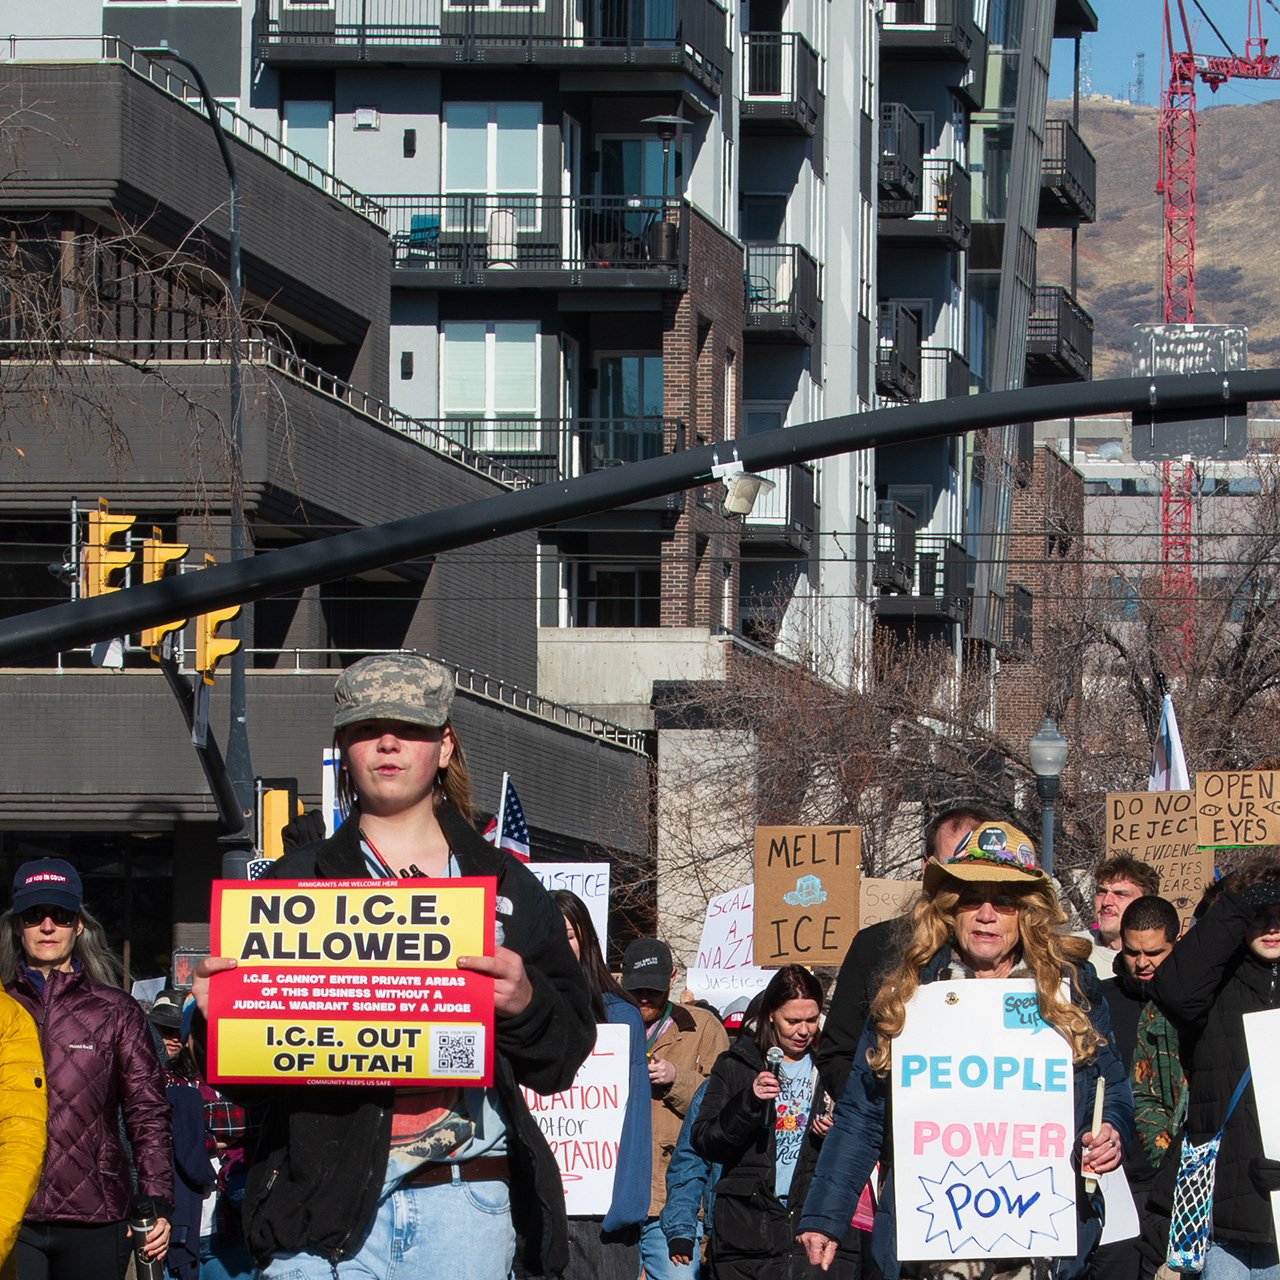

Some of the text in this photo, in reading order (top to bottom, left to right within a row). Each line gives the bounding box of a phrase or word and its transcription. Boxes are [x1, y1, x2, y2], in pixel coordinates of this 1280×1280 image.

[1204, 773, 1273, 799] OPEN
[1114, 795, 1195, 820] DO NO
[1228, 801, 1258, 817] UR
[1213, 818, 1267, 843] EYES
[767, 829, 851, 868] MELT
[1144, 843, 1202, 862] EVIDENCE
[1169, 861, 1202, 876] EYES
[1163, 877, 1202, 893] EARS
[249, 894, 316, 926] NO
[335, 894, 451, 927] I.C.E.
[709, 889, 753, 917] SCAL
[725, 919, 738, 941] A
[770, 915, 841, 958] ICE
[240, 931, 452, 962] ALLOWED
[243, 974, 466, 987] I.C.E. CANNOT ENTER PRIVATE AREAS
[697, 974, 766, 990] Justice
[261, 987, 443, 1000] OF THIS BUSINESS WITHOUT A
[233, 1000, 471, 1013] JUDICIAL WARRANT SIGNED BY A JUDGE
[1005, 996, 1038, 1015] Spea
[266, 1026, 422, 1049] I.C.E. OUT
[273, 1052, 414, 1074] OF UTAH
[901, 1055, 1068, 1092] PEOPLE
[913, 1121, 1067, 1159] POWER
[945, 1183, 1041, 1230] POW
